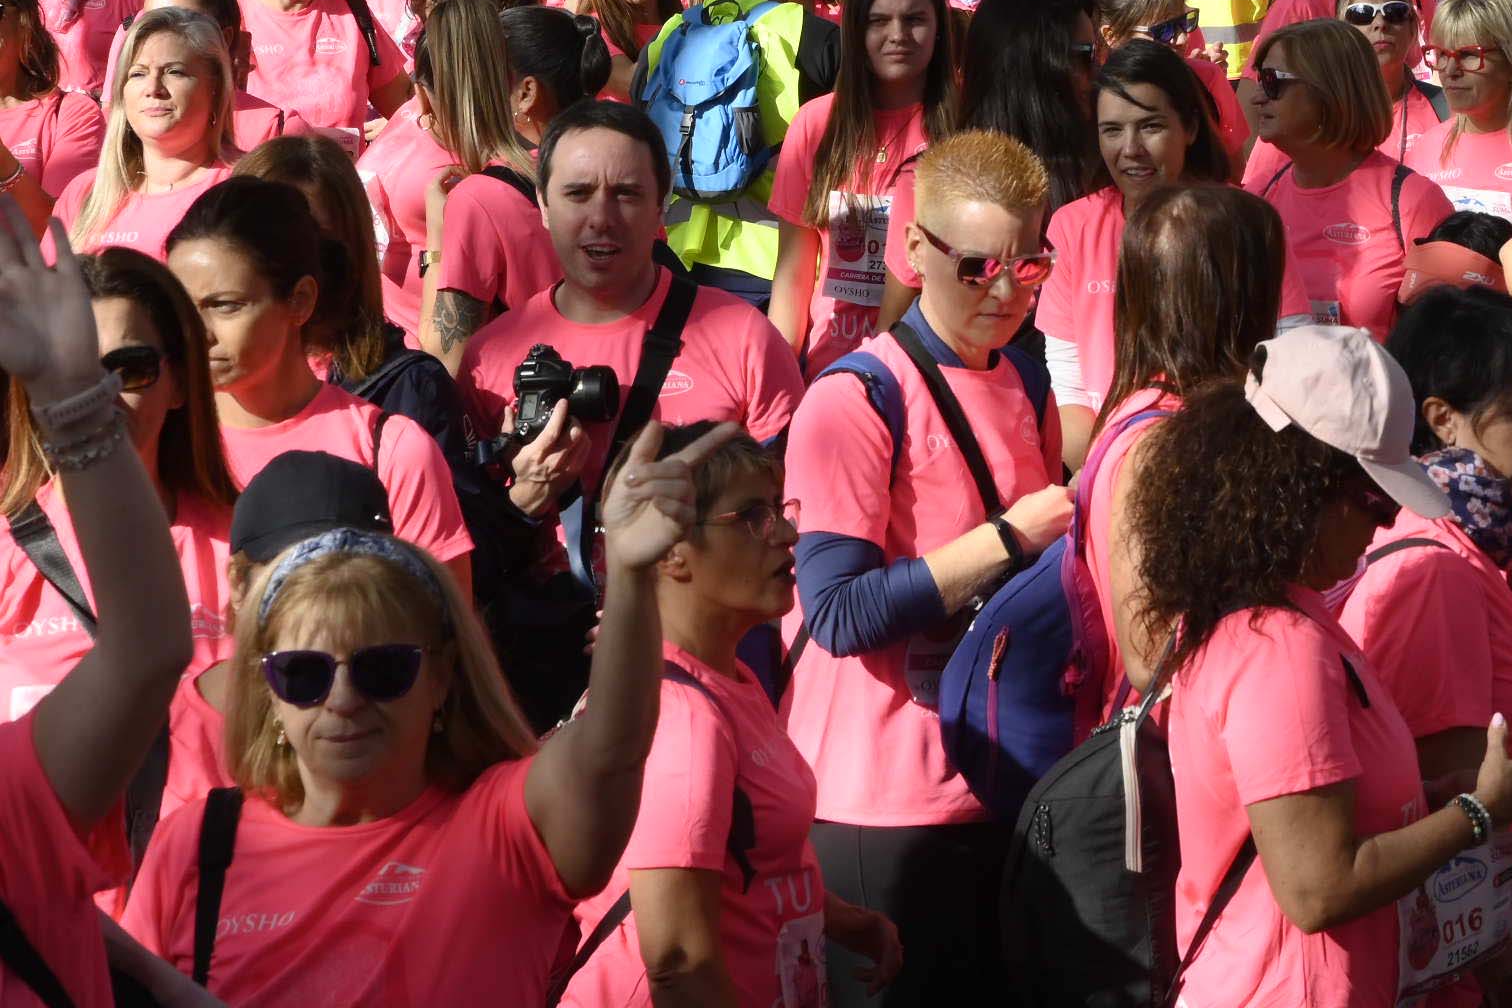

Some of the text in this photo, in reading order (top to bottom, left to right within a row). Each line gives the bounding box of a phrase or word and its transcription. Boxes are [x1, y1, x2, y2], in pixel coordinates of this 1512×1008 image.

[1462, 271, 1495, 286] 2XU
[830, 314, 877, 339] SUM
[14, 617, 78, 639] OYSH
[365, 880, 421, 894] STURIAN
[764, 869, 812, 915] TU
[1442, 907, 1483, 944] 016
